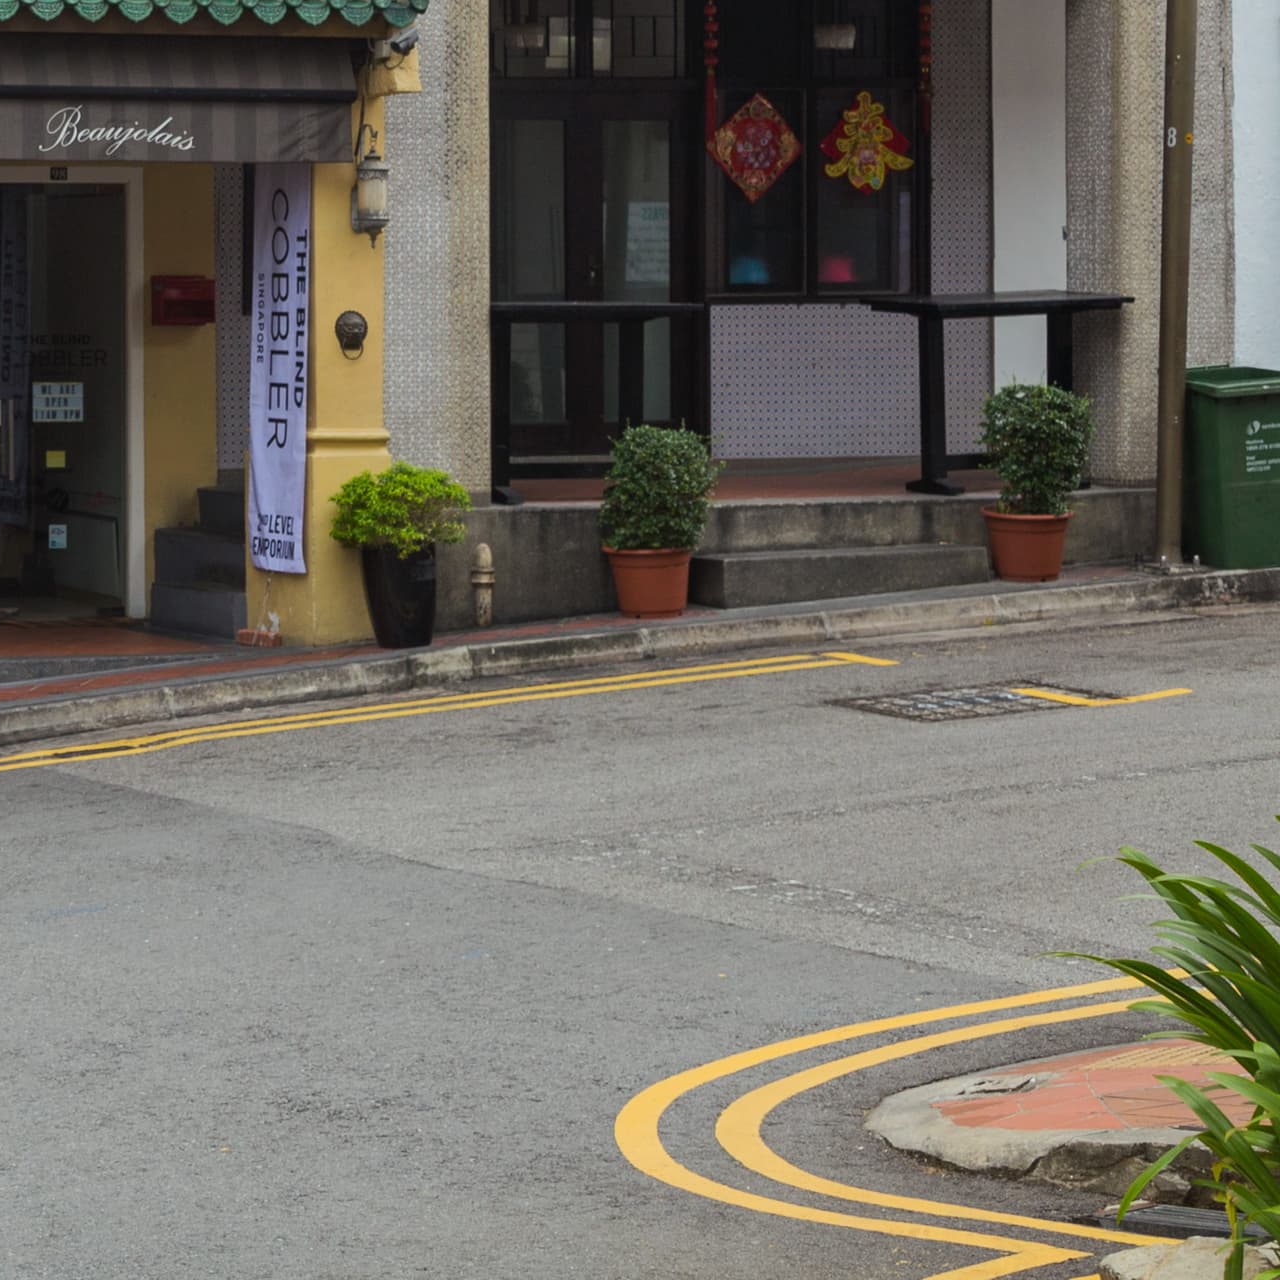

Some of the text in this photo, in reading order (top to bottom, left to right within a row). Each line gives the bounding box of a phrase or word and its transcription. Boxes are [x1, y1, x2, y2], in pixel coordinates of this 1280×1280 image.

[38, 104, 196, 156] Beaujolais
[1167, 127, 1177, 148] 8
[256, 272, 266, 364] SINGAPORE
[266, 188, 290, 450] COBBLER
[293, 229, 308, 409] THE BLIND
[253, 536, 296, 561] EMPORIUM
[269, 514, 295, 536] LEVEL
